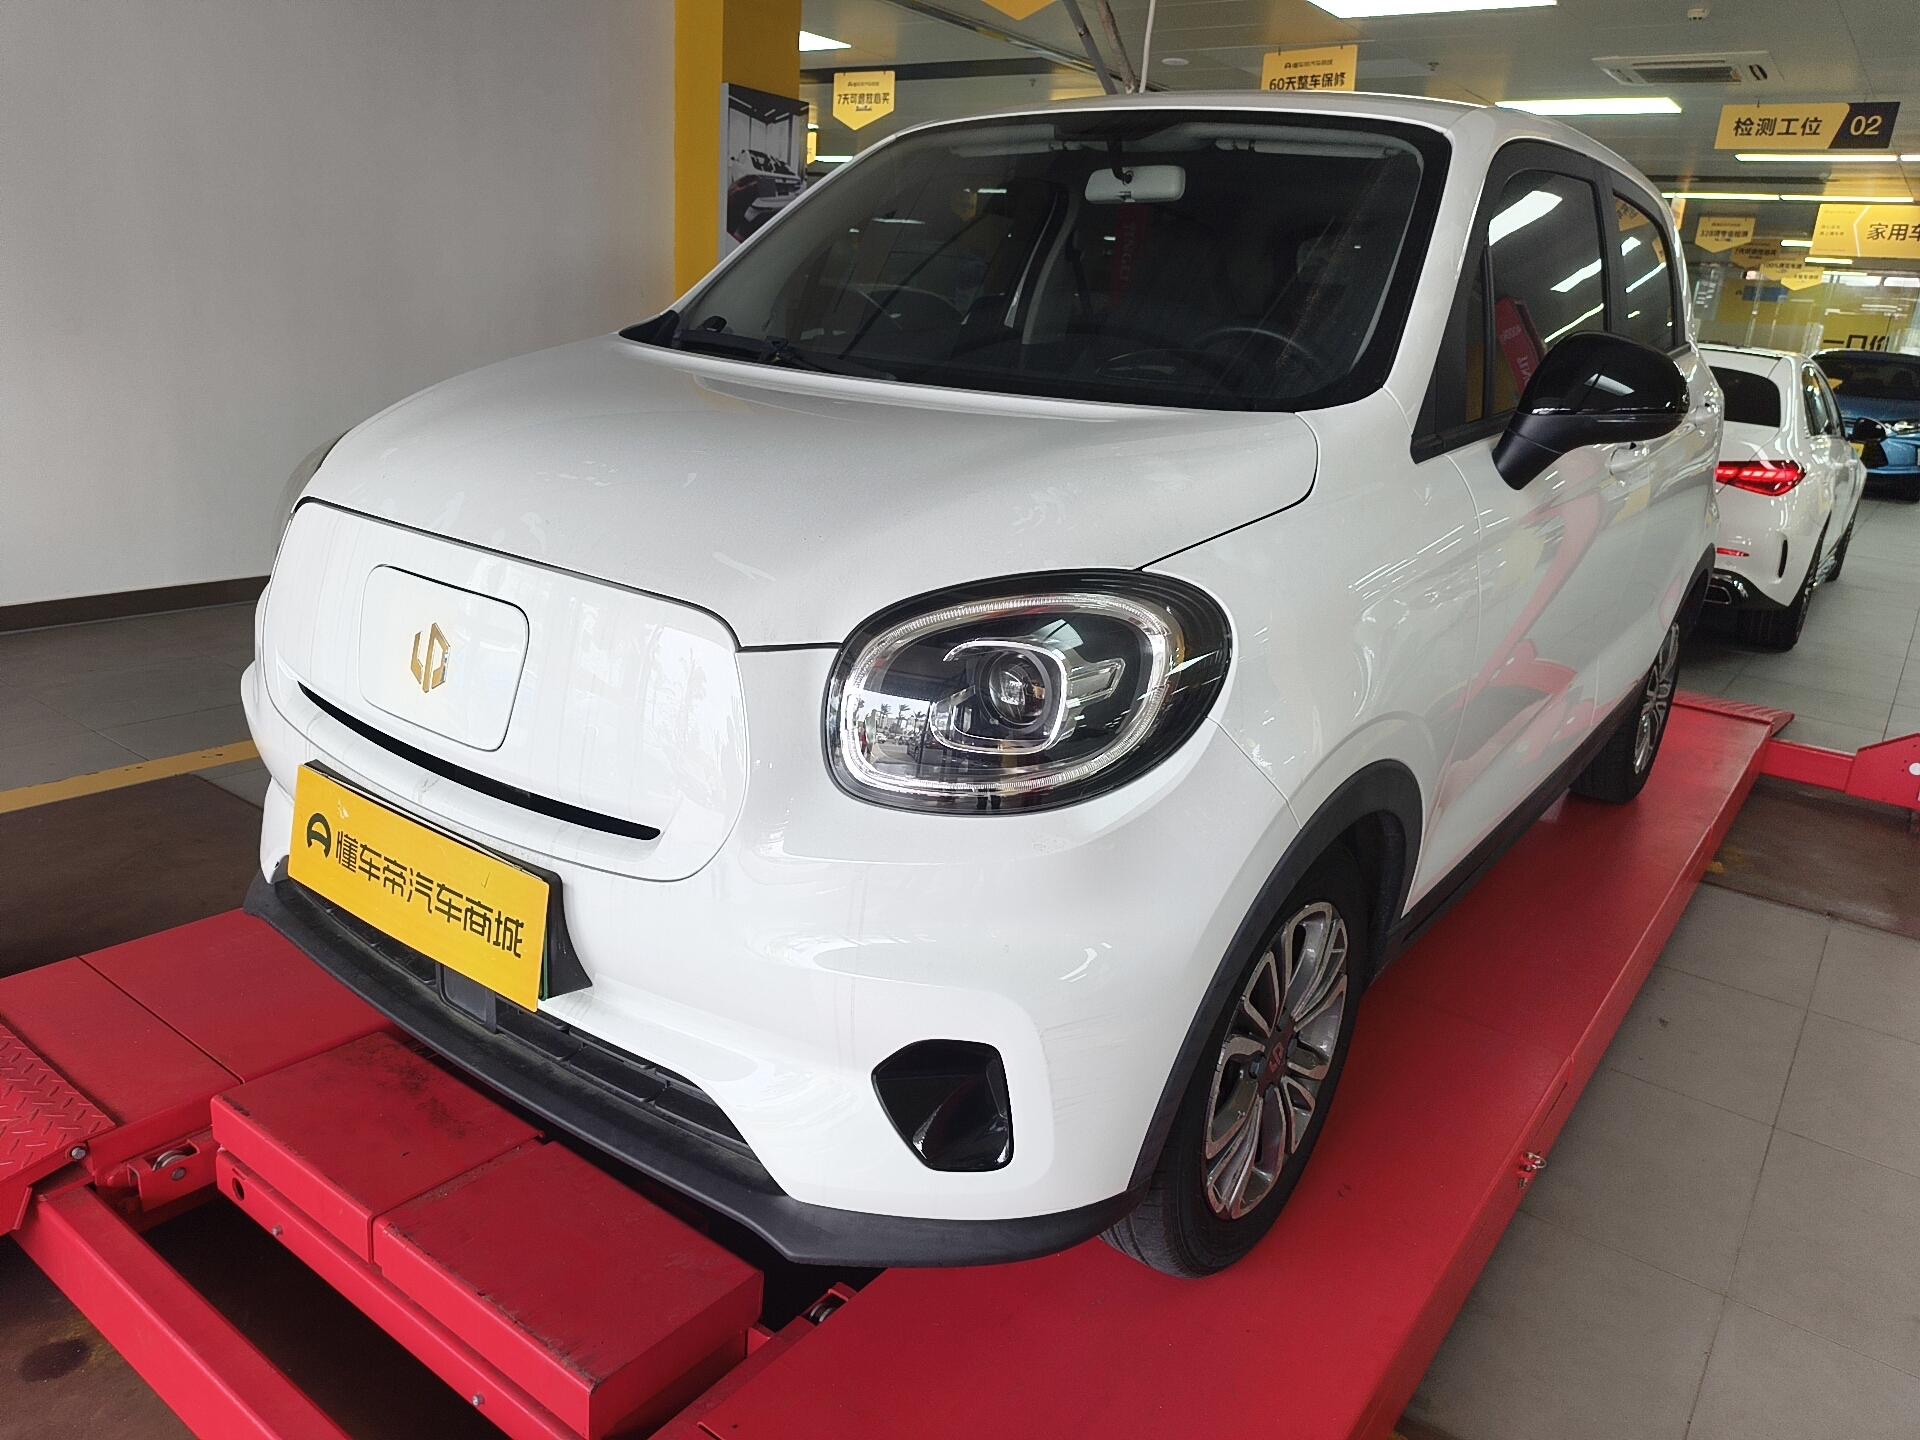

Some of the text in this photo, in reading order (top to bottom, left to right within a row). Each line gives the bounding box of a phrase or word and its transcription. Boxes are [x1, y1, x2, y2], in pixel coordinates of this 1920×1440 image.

[1269, 72, 1346, 91] 60天整车保修
[1733, 115, 1882, 136] 检测工位 02
[335, 830, 525, 959] 懂车帝汽车商城
